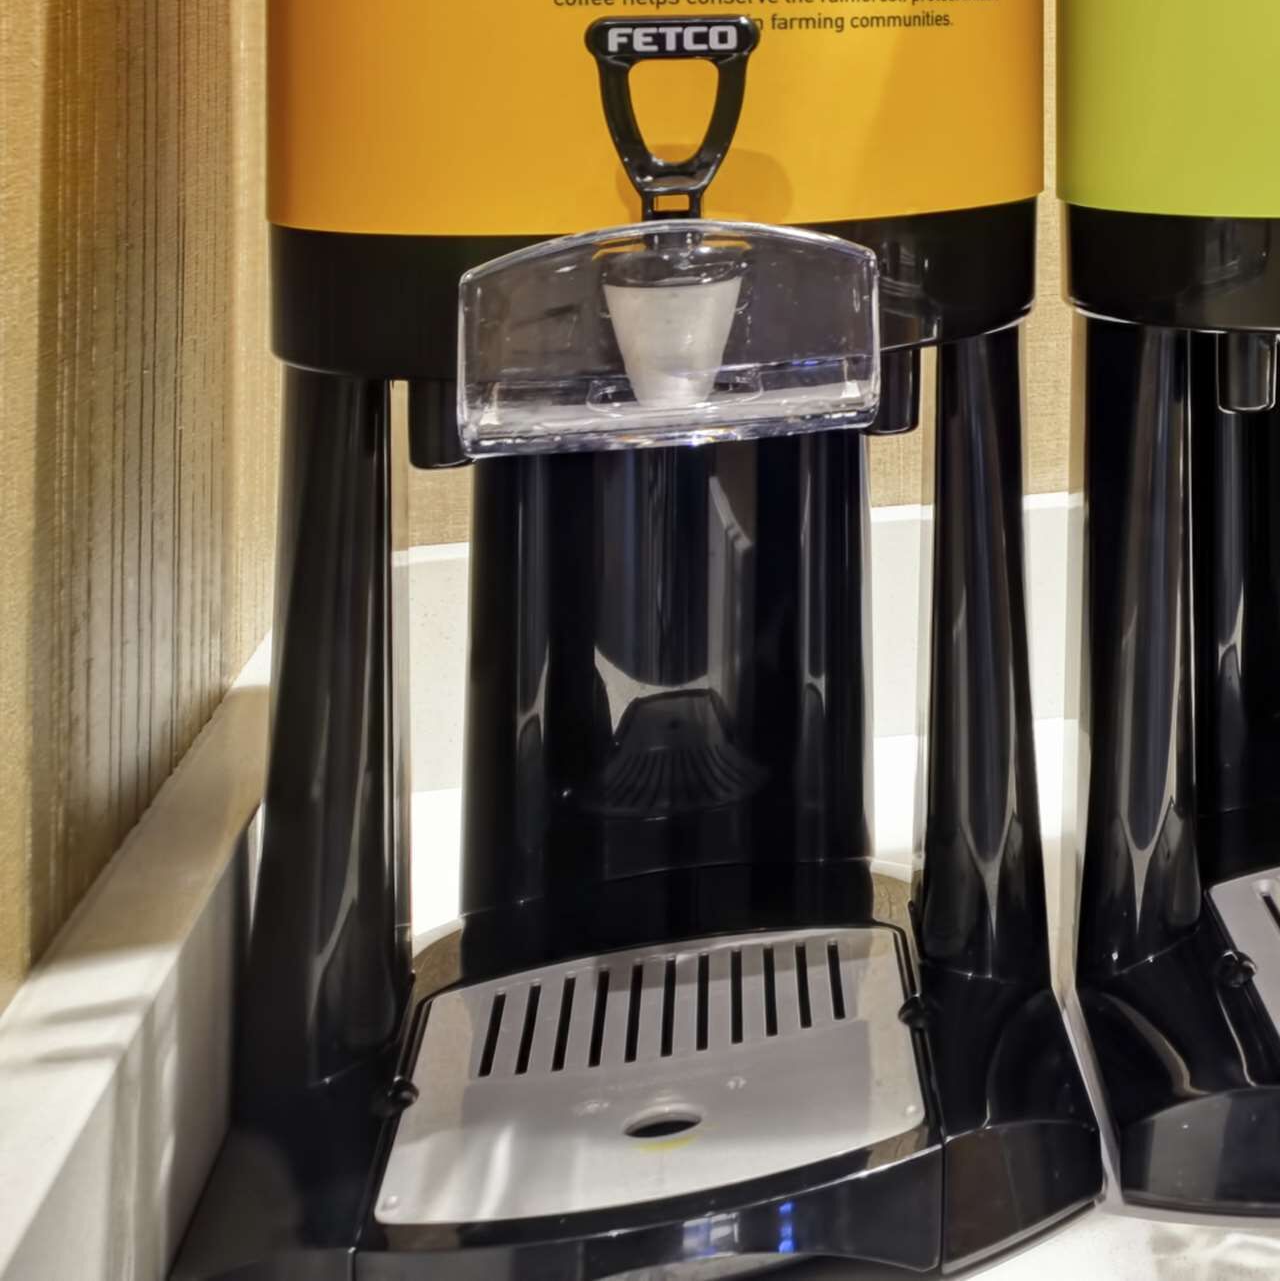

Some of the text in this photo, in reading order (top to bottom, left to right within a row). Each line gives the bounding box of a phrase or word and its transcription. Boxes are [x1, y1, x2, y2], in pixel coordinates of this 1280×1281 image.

[771, 14, 845, 33] farming
[850, 10, 953, 29] communities.
[607, 25, 738, 53] FETCO
